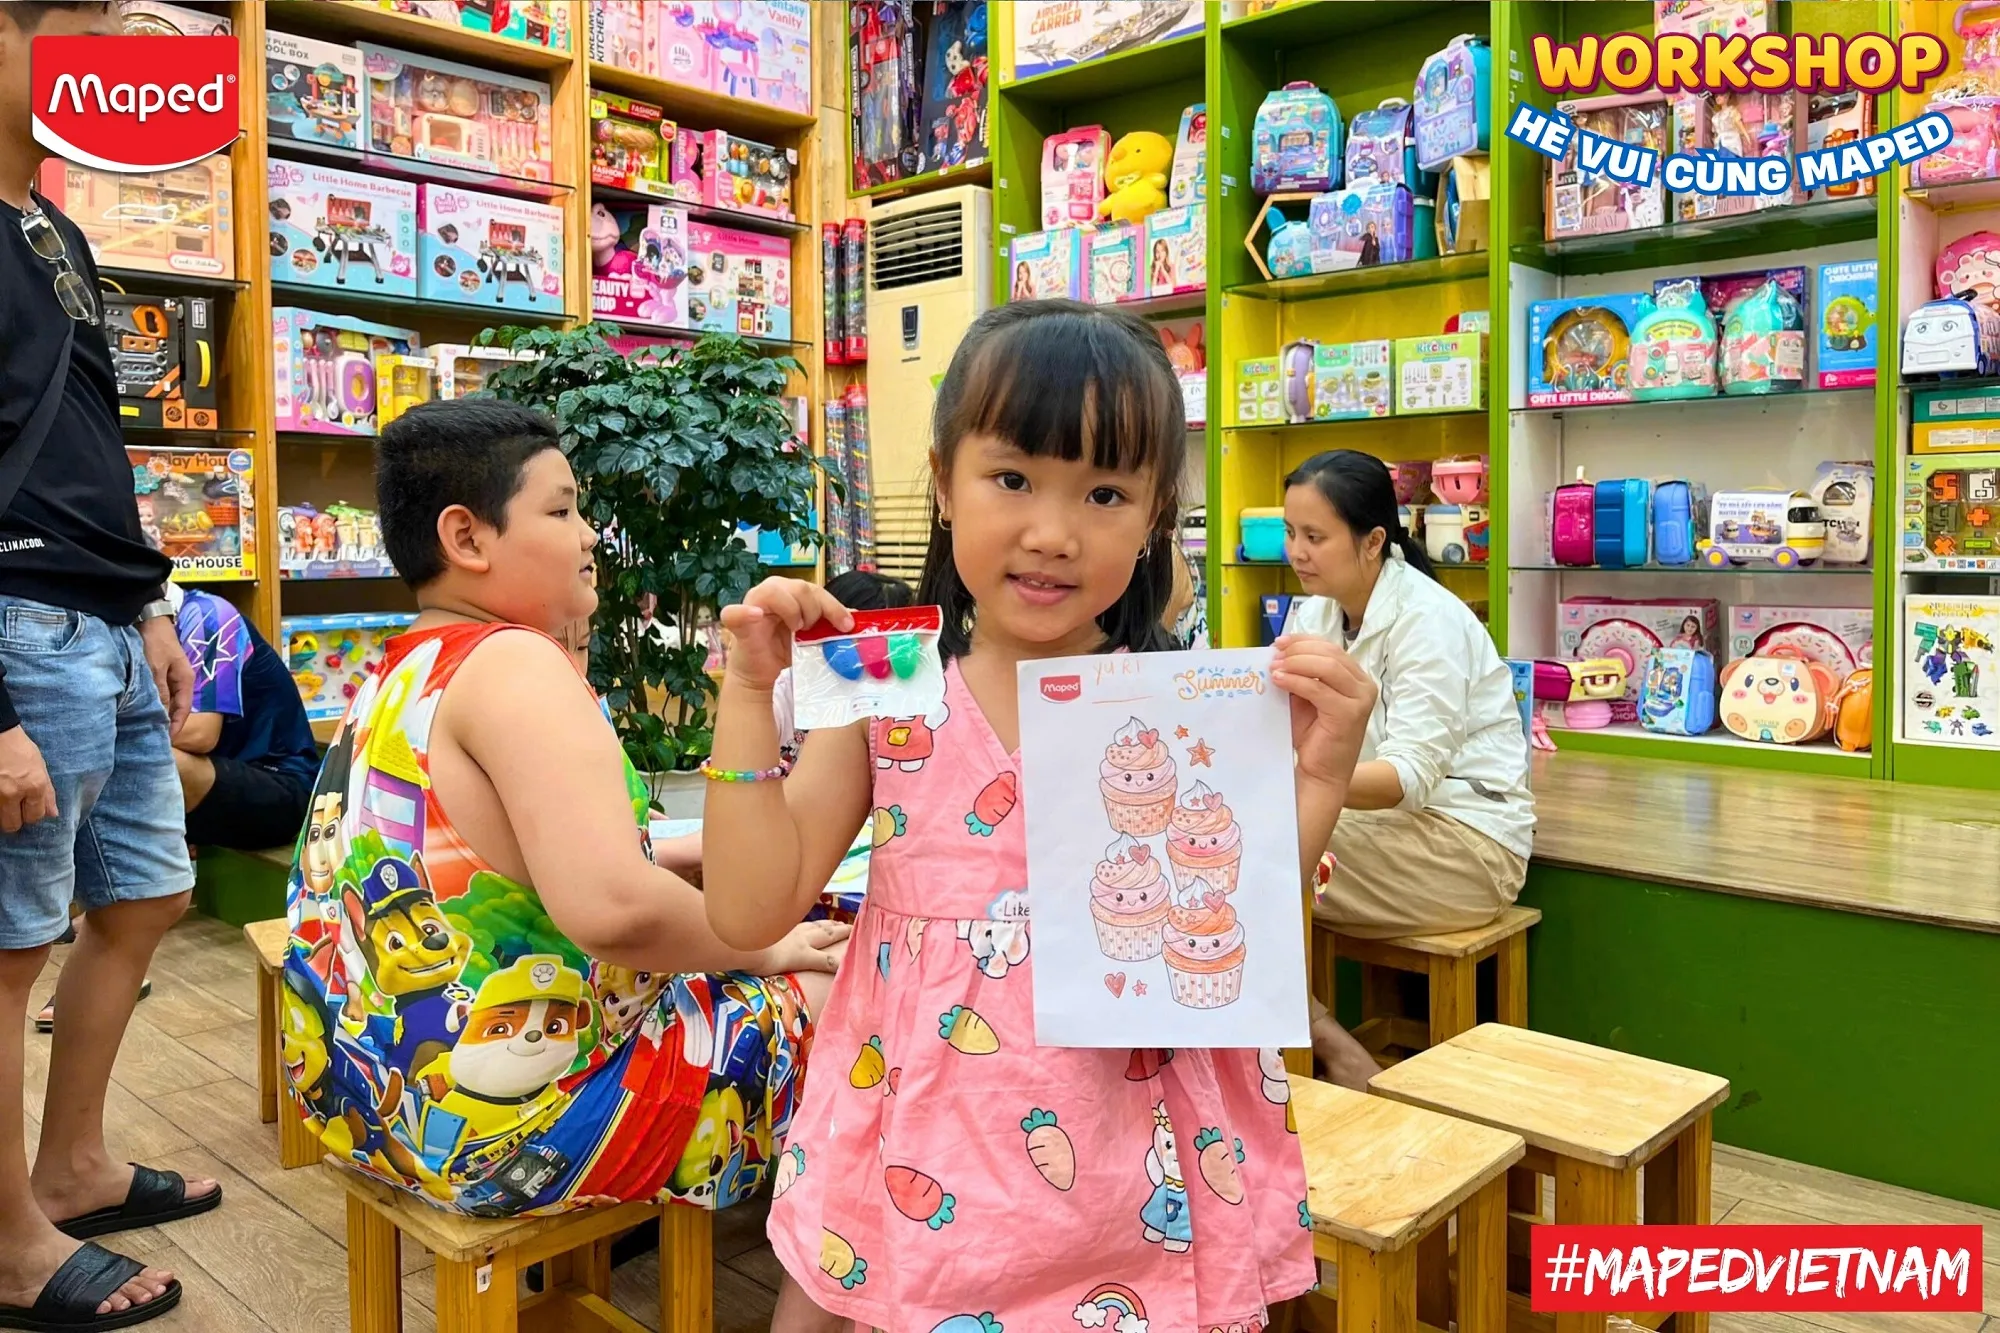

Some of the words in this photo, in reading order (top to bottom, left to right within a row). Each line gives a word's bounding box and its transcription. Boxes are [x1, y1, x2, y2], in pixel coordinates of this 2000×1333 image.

[765, 0, 805, 17] antasy
[767, 8, 802, 29] Vanity
[1031, 9, 1082, 35] CARRIER
[596, 8, 604, 62] KITCHEN
[273, 39, 298, 48] PLANE
[266, 44, 286, 55] OOL
[288, 49, 309, 60] BOX
[631, 104, 660, 117] FASHION
[592, 164, 625, 178] FASHION
[312, 172, 338, 184] Little
[340, 178, 368, 190] Home
[369, 184, 412, 198] Barbecue
[476, 199, 498, 210] Little
[500, 205, 523, 215] Home
[524, 210, 560, 221] Barbecue
[593, 279, 630, 298] EAUTY
[593, 296, 616, 312] HOP
[1415, 339, 1458, 353] Kitchen
[196, 453, 228, 467] Hou
[0, 537, 46, 553] CLIMACOOL
[196, 557, 243, 569] HOUSE
[1043, 682, 1080, 693] Maped
[1174, 668, 1267, 701] Summer
[1003, 900, 1031, 917] Like
